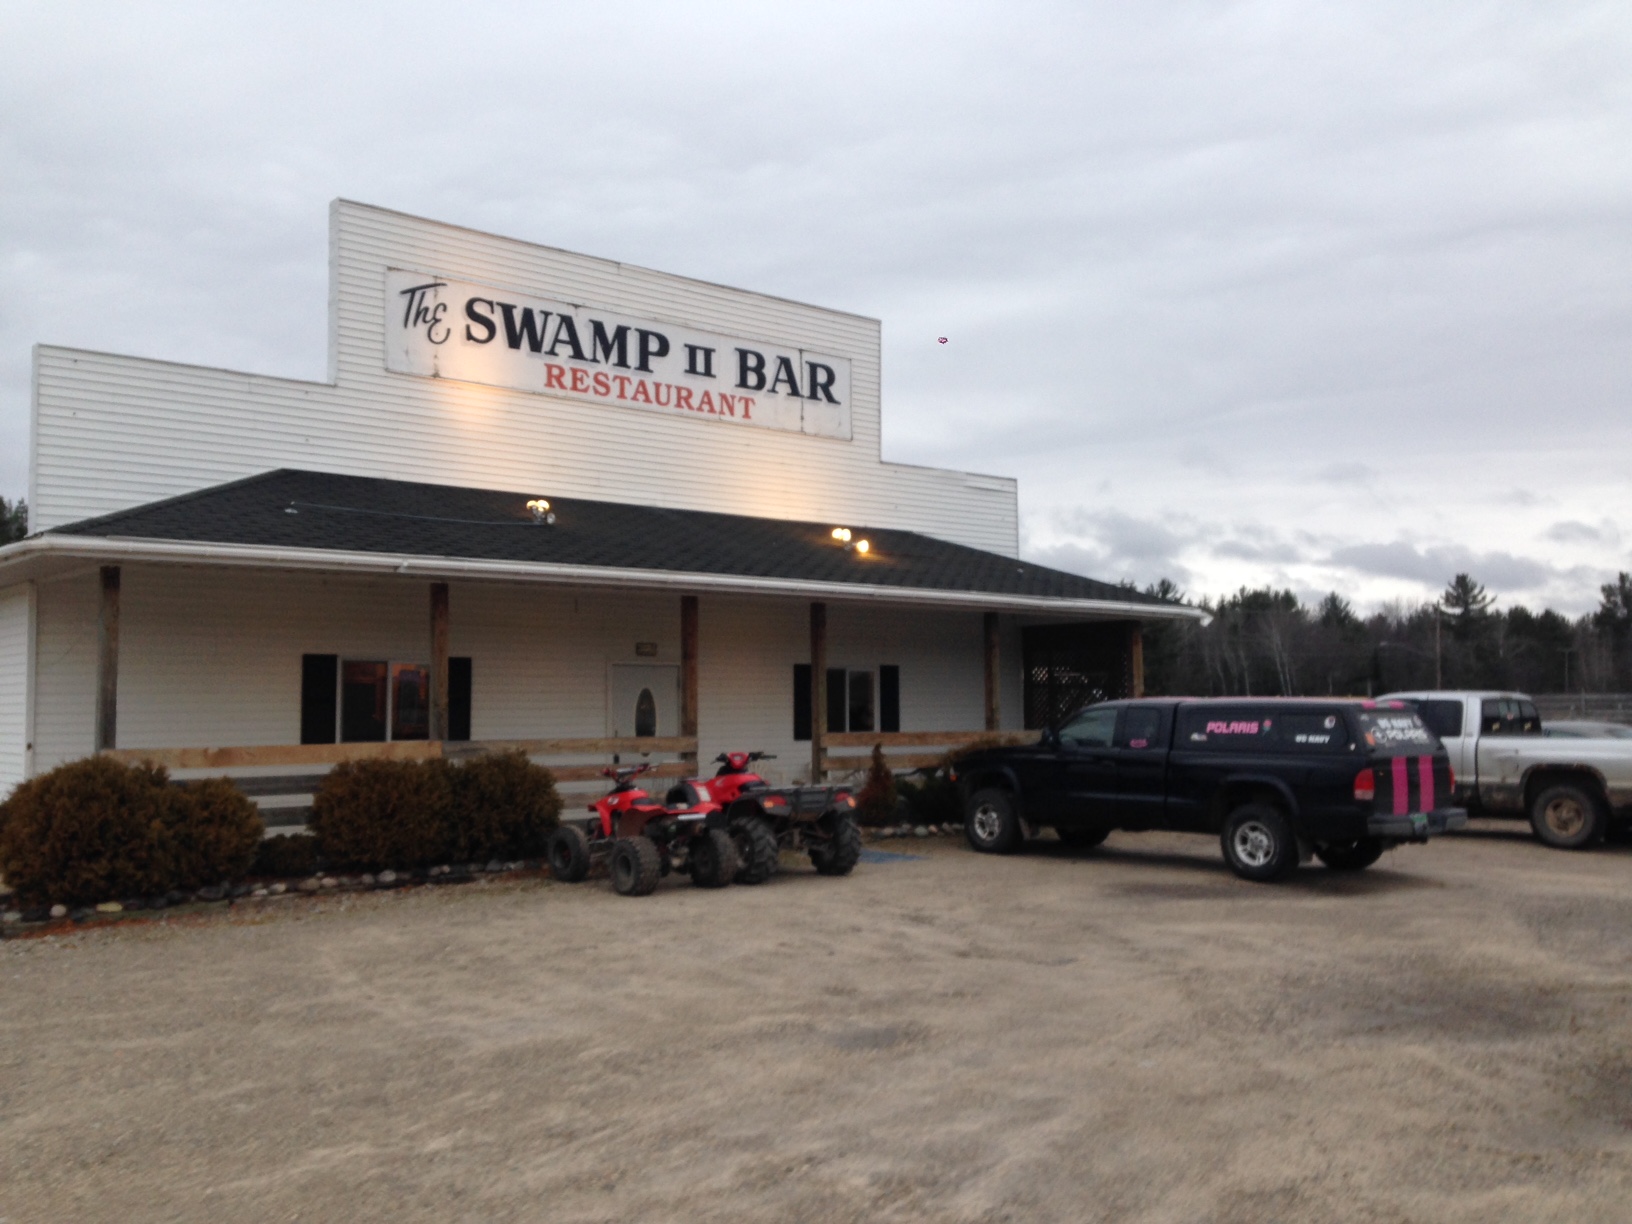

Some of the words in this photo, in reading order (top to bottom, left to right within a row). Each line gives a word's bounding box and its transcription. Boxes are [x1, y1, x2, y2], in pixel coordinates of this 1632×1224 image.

[464, 297, 671, 374] SWAMP
[683, 342, 718, 379] II
[735, 347, 842, 406] BAR
[544, 362, 757, 420] RESTAURANT
[1206, 721, 1260, 734] POLARIS
[1295, 734, 1307, 743] US
[1308, 734, 1330, 744] NAVY
